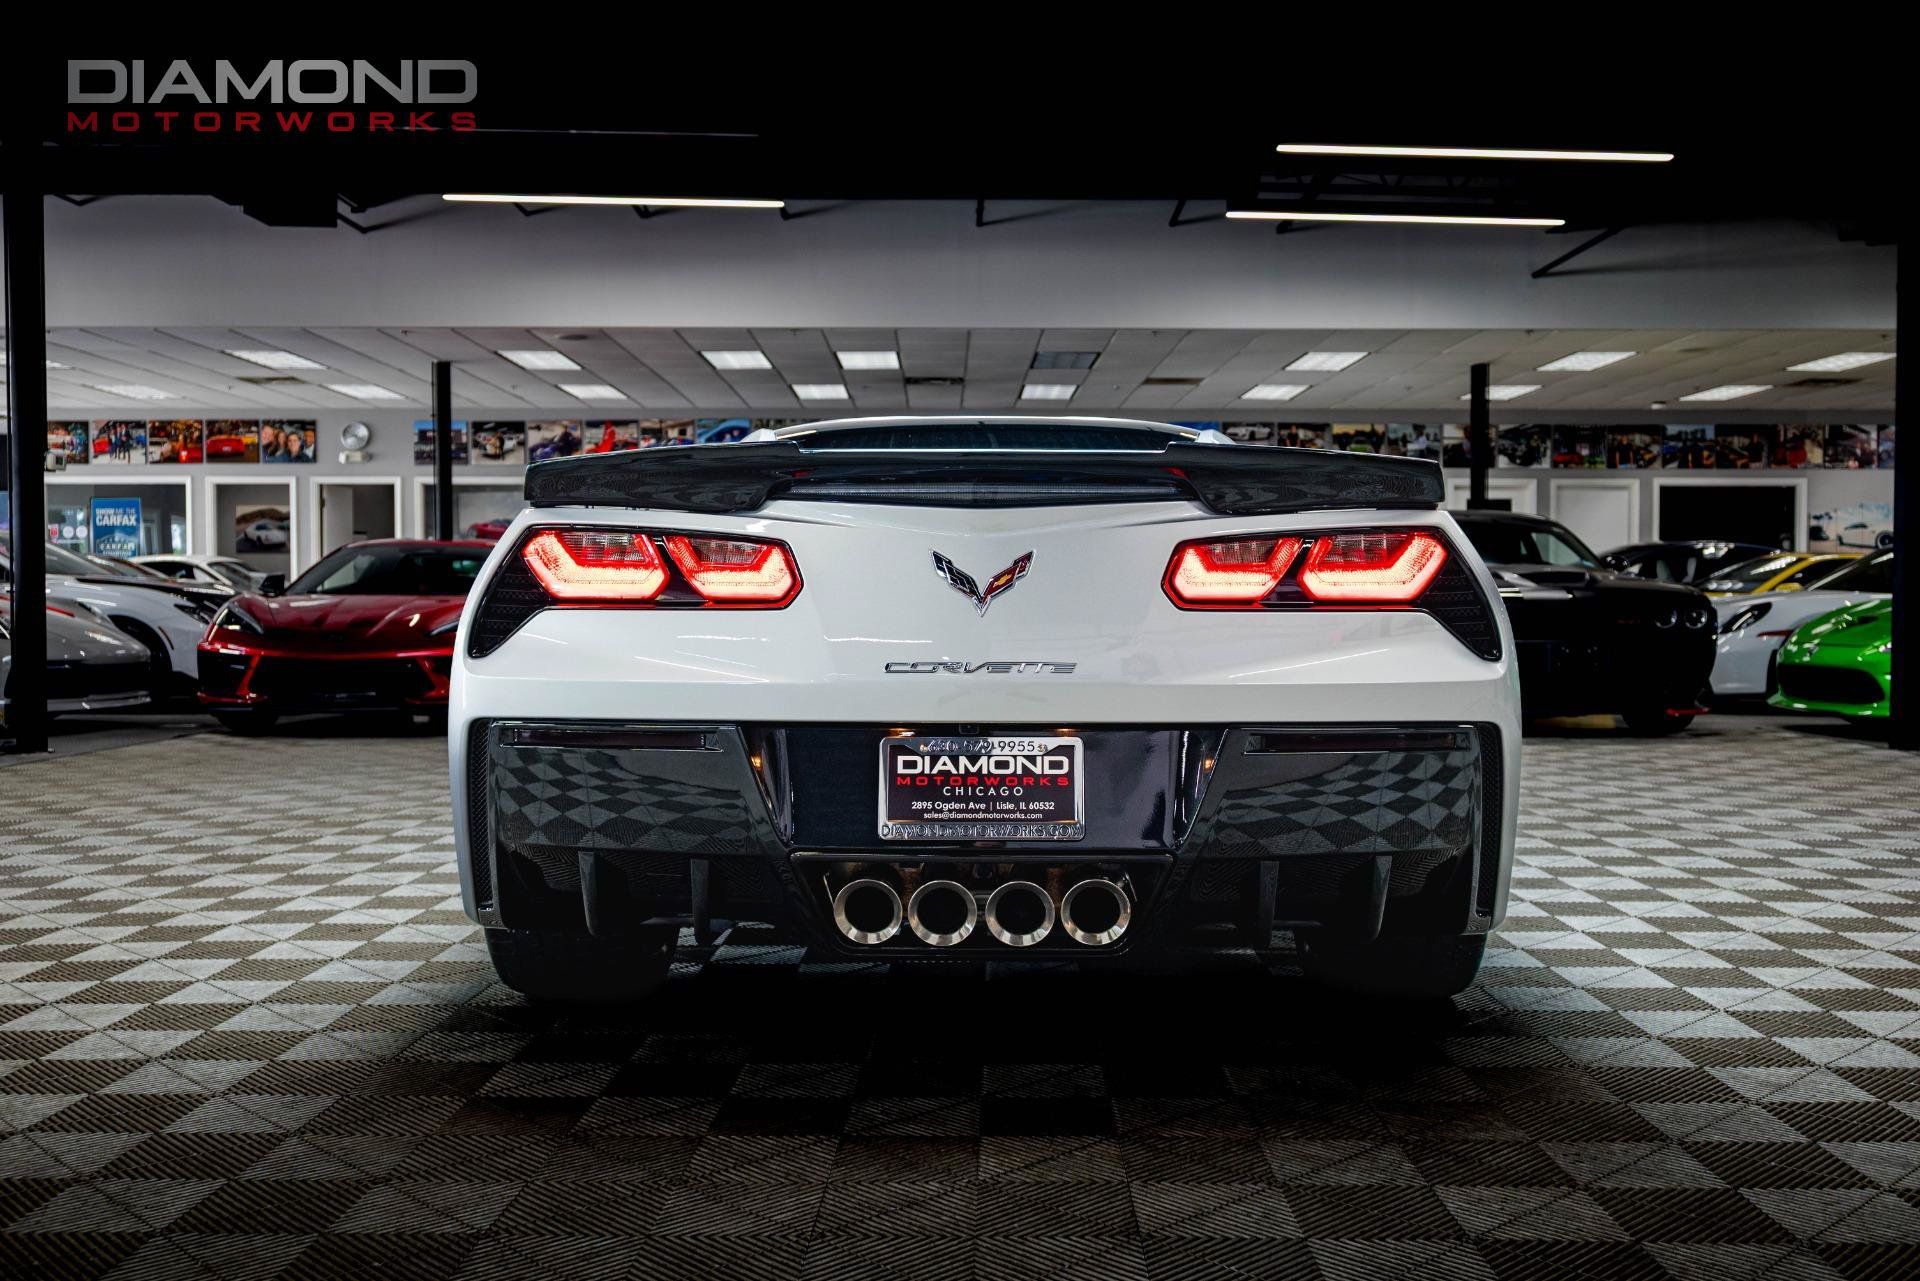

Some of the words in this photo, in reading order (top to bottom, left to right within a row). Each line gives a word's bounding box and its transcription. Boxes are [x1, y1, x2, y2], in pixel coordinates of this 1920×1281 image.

[96, 515, 137, 527] CARFAX
[884, 661, 1078, 674] CORVETTE
[896, 755, 1070, 775] DIAMOND
[896, 776, 1070, 786] MOTORWORKS
[943, 786, 1024, 796] CHICAGO
[911, 802, 933, 810] 2895
[935, 802, 967, 812] Ogden
[968, 802, 986, 810] Ave
[996, 801, 1017, 811] Lisle,
[1019, 802, 1027, 810] IL
[1028, 802, 1055, 810] 60532
[923, 811, 1043, 820] sales@diamondmotorworks.com
